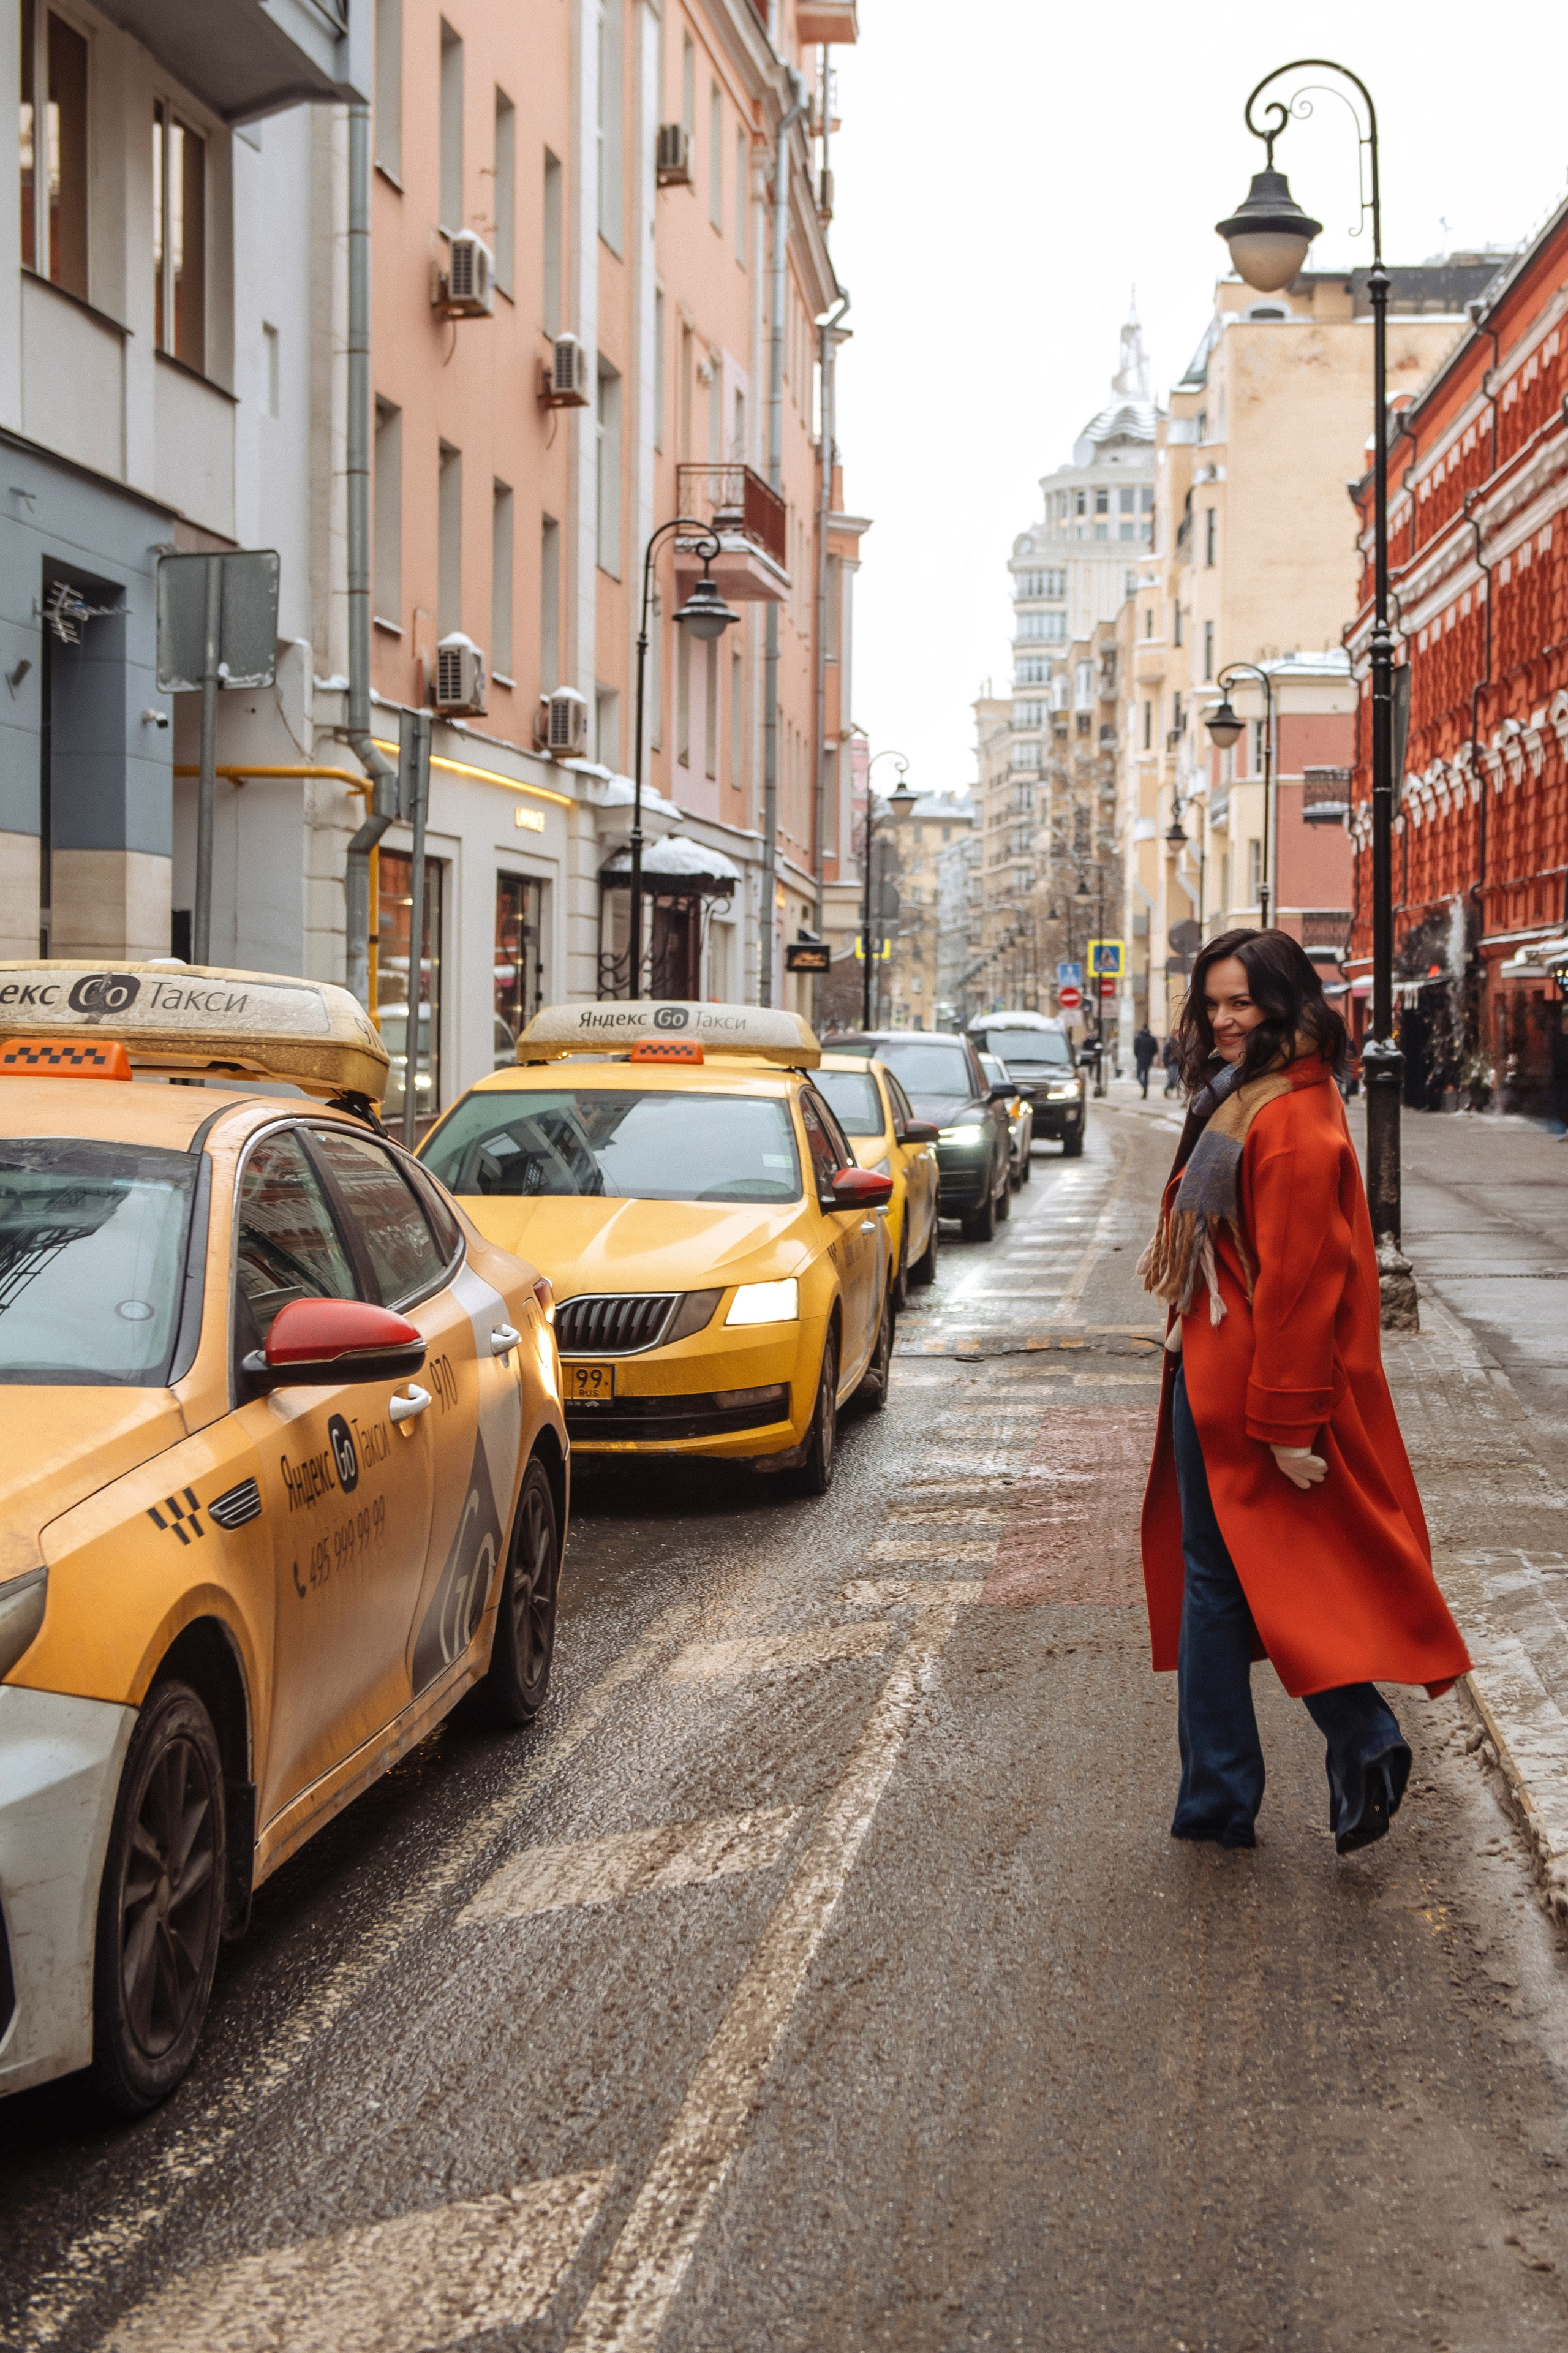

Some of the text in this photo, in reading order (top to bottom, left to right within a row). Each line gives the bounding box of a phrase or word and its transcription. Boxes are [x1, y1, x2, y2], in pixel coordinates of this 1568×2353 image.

[149, 981, 249, 1013] Такси
[579, 1008, 747, 1030] Яндекс Go Такси
[429, 1354, 458, 1414] 970
[576, 1369, 603, 1388] 99
[579, 1388, 599, 1397] RUS
[280, 1418, 391, 1513] Яндекс Go Такси
[309, 1495, 386, 1590] 495 999 99 99
